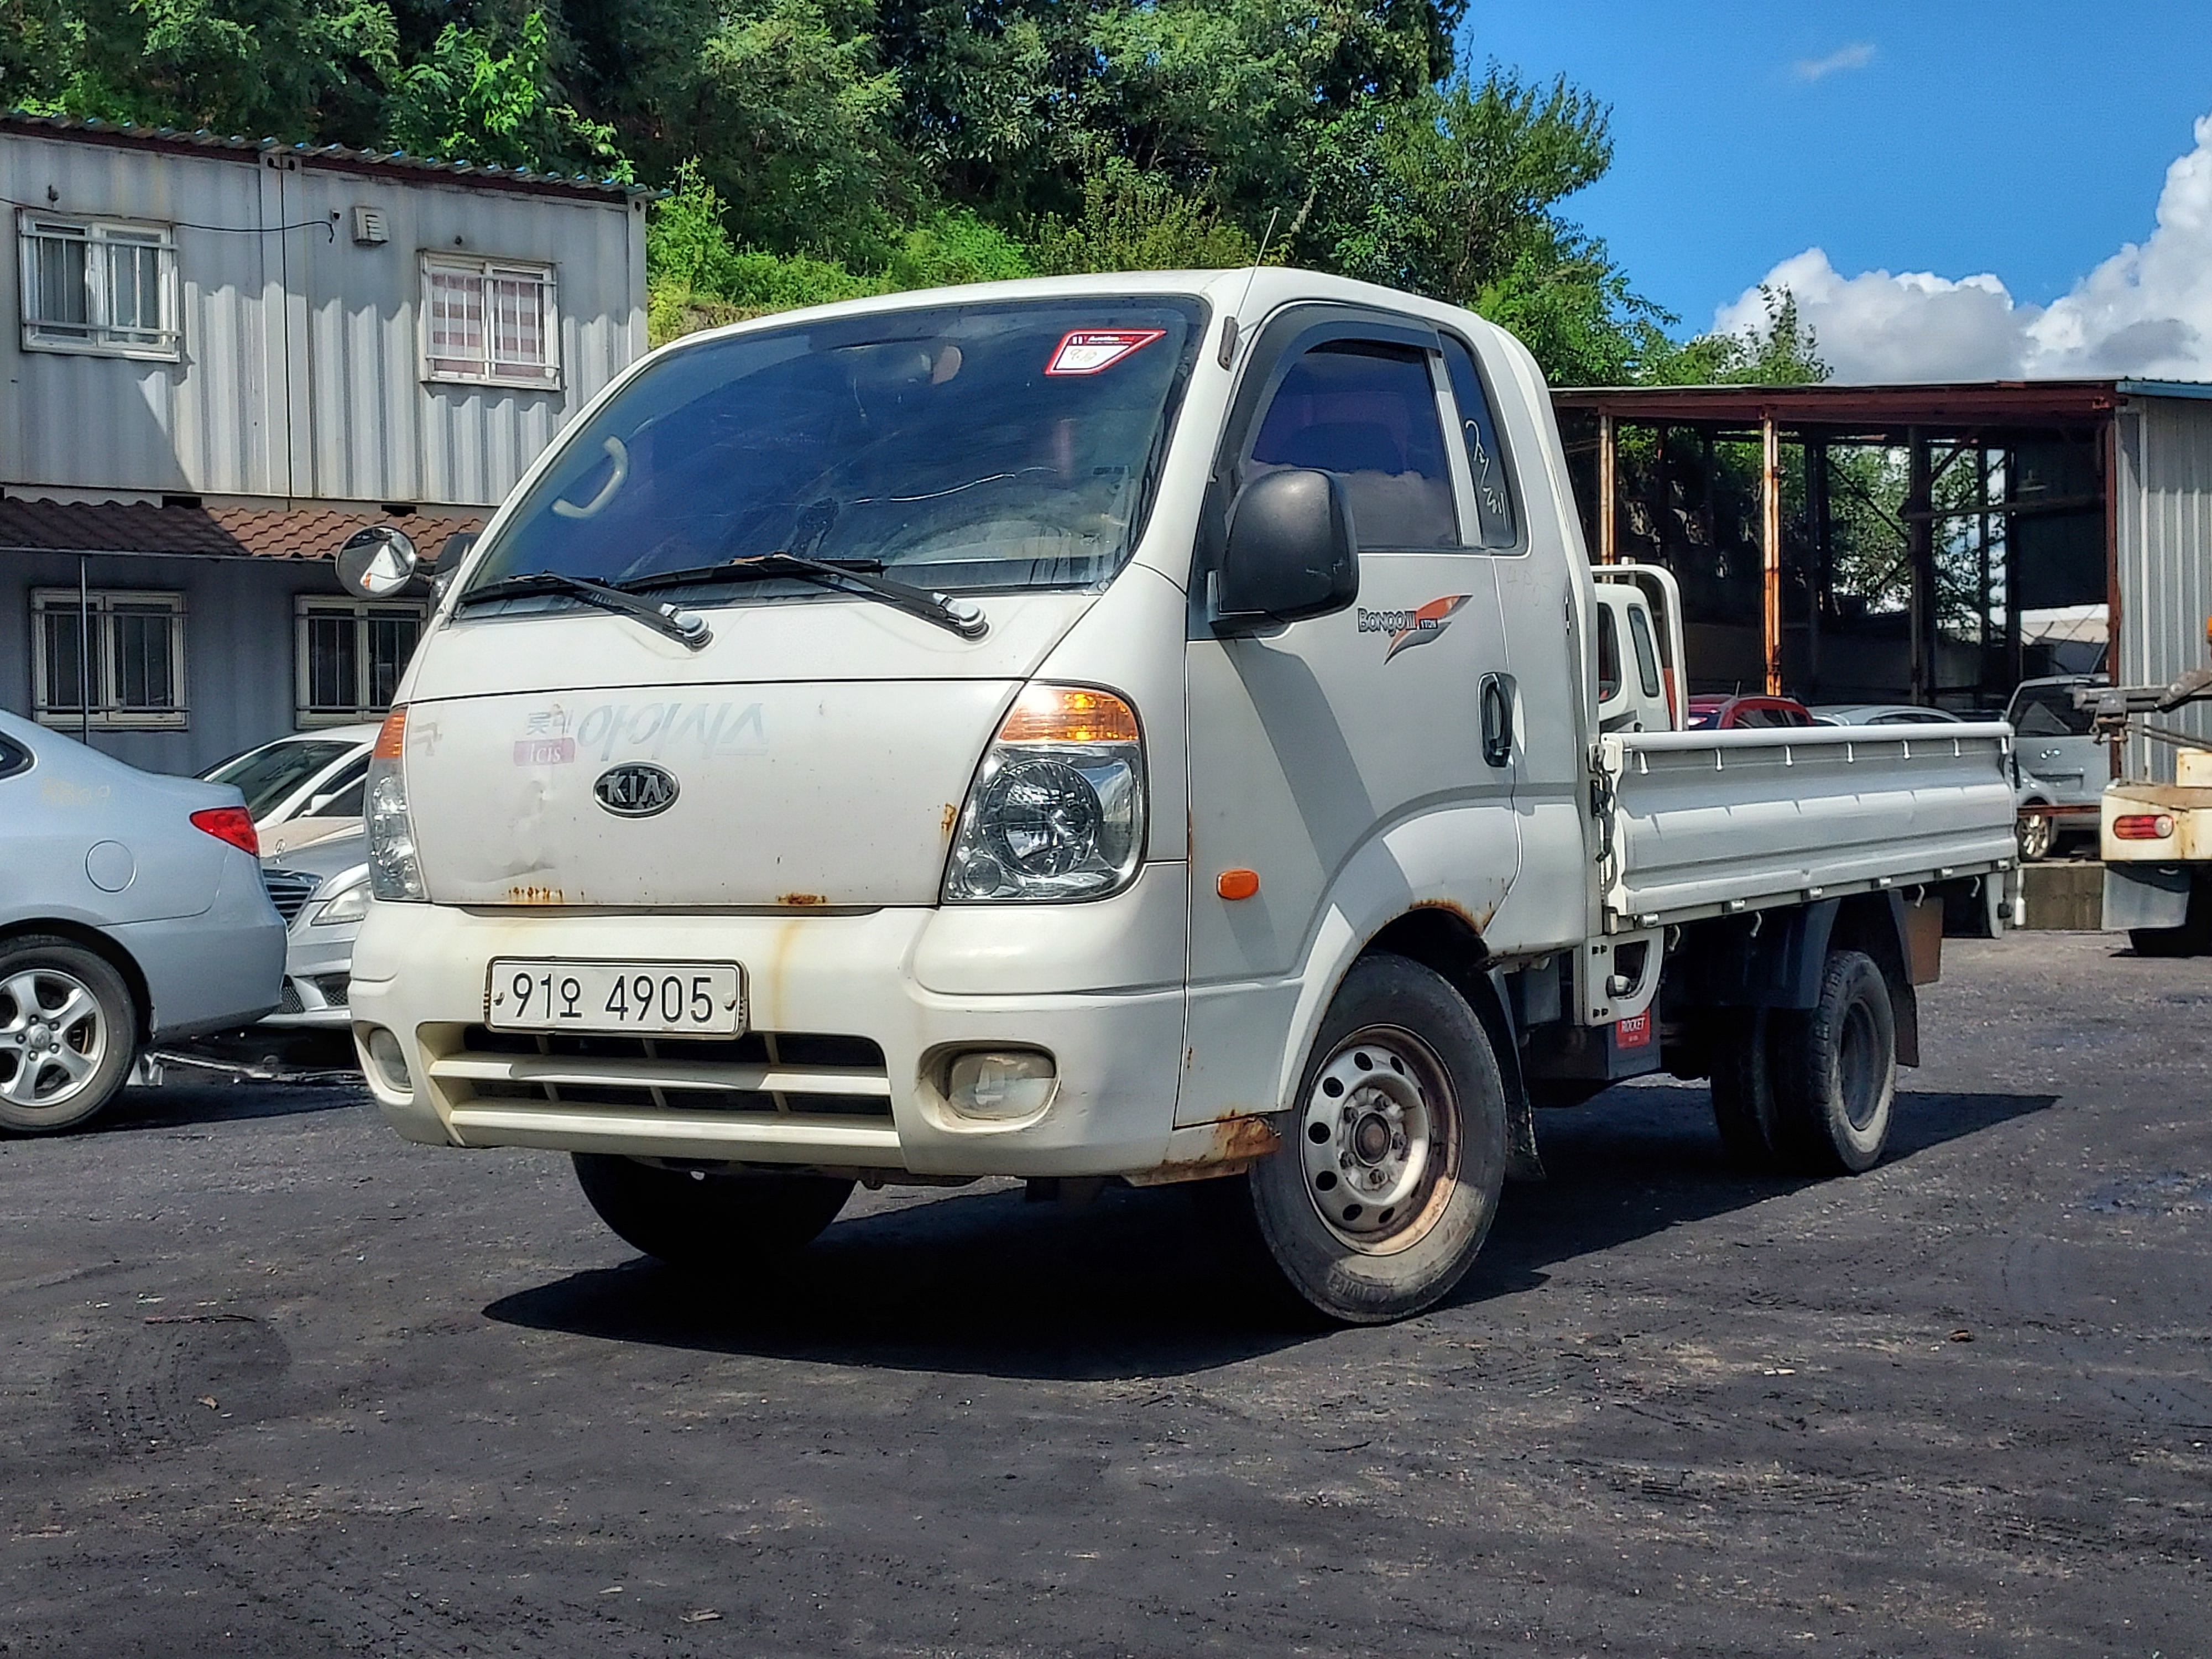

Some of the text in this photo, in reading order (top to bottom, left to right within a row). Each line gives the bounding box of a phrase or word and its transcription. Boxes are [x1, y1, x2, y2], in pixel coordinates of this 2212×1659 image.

[526, 711, 574, 735] 롯데
[607, 775, 665, 802] KIA
[512, 972, 713, 1023] 91오 4905
